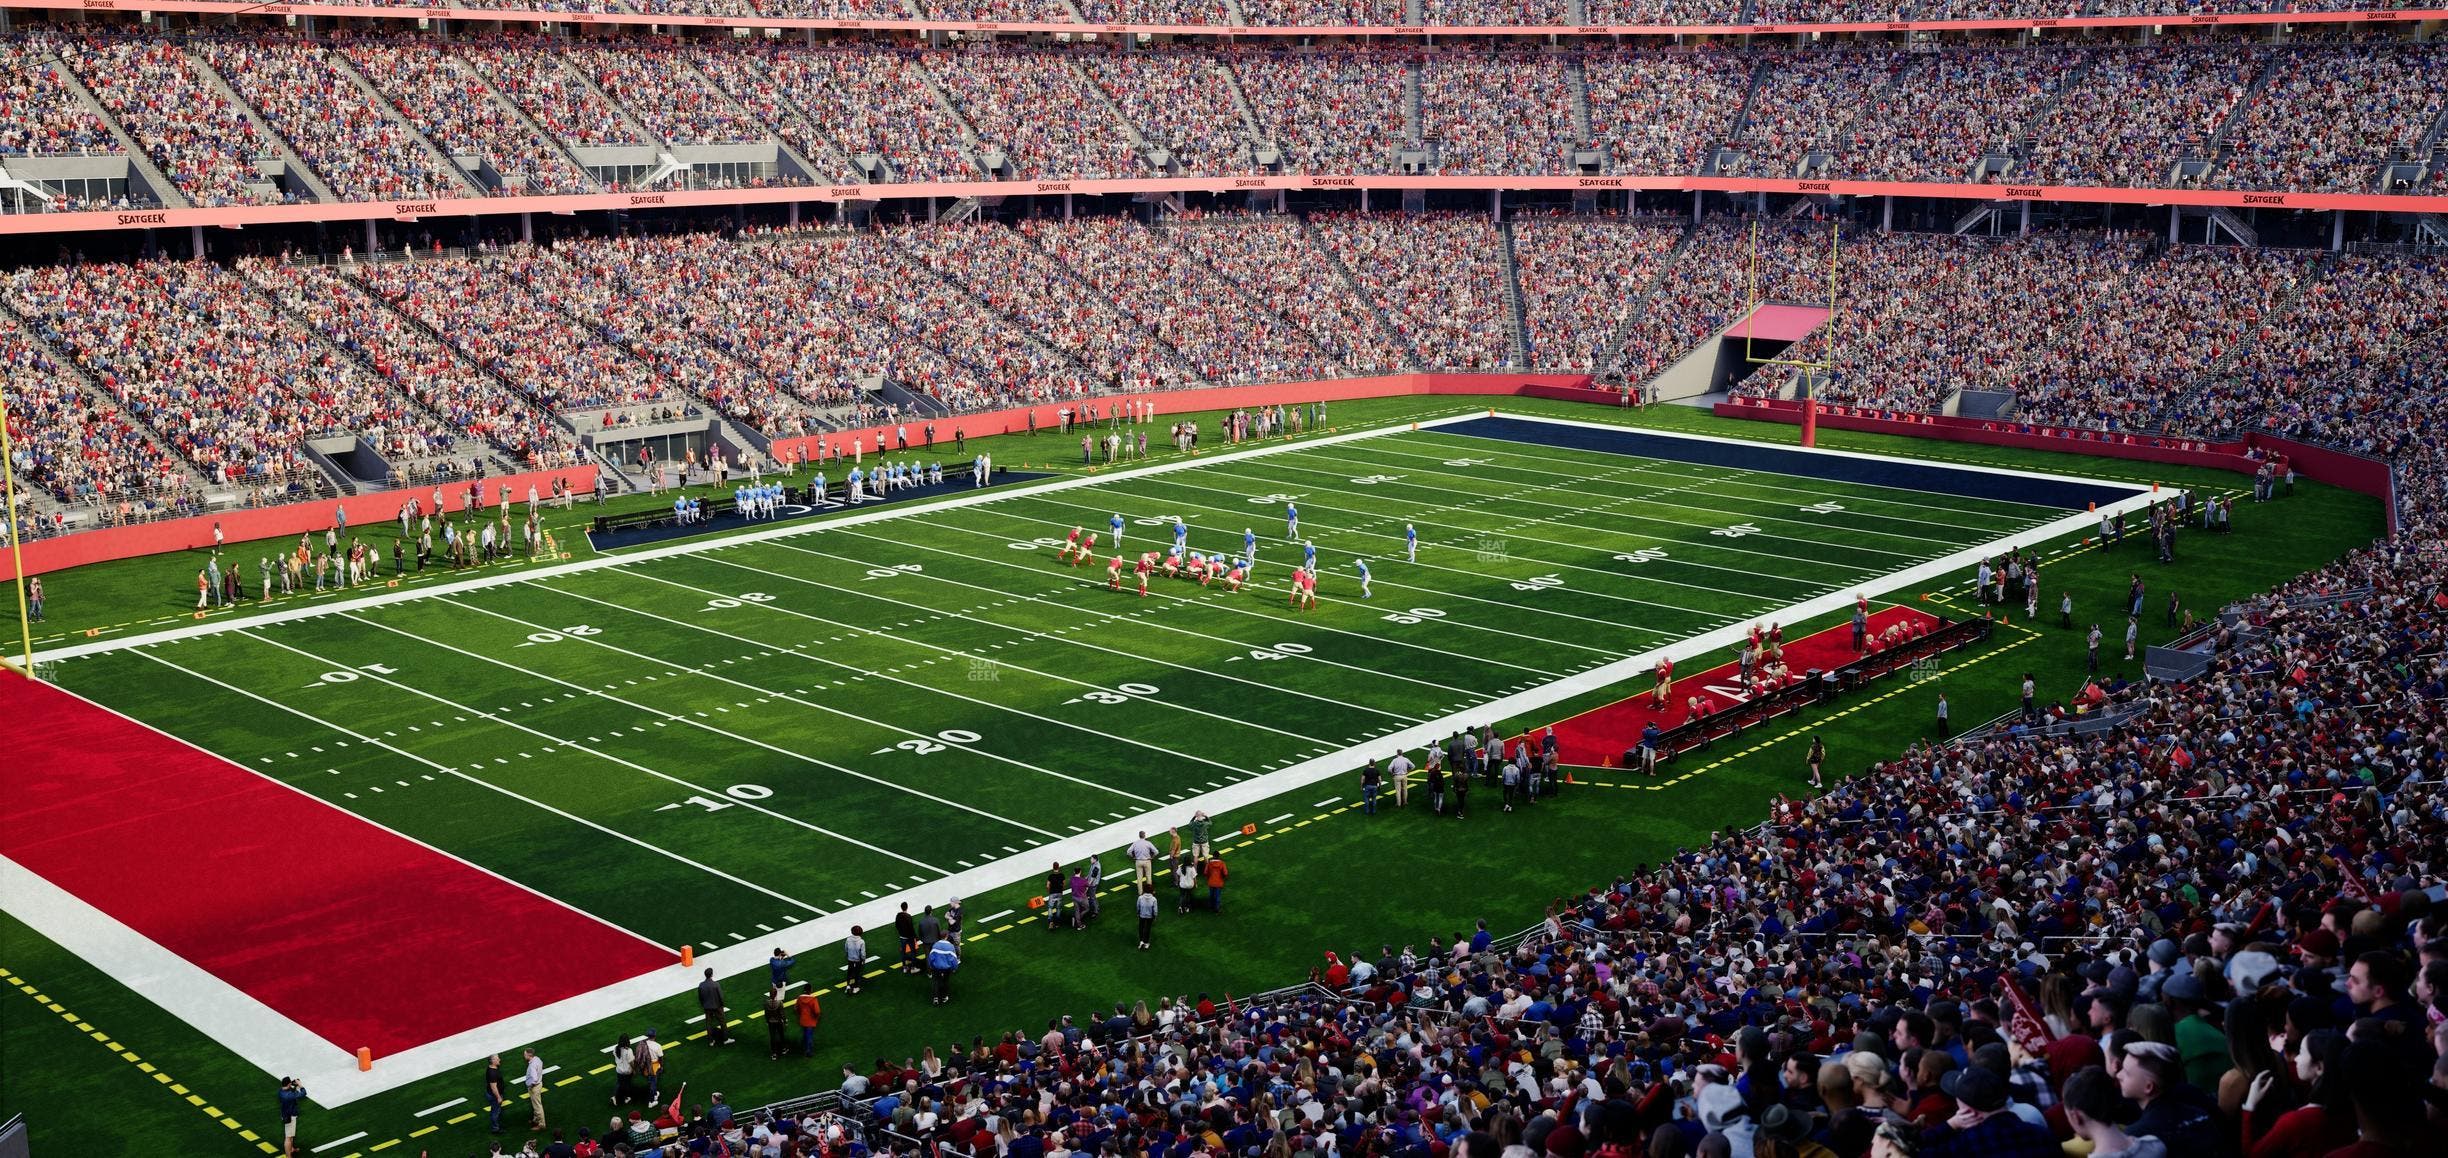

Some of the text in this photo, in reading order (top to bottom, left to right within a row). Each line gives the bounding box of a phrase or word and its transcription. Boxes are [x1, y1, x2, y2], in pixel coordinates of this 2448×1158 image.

[84, 0, 114, 8] SEATGEEK
[264, 5, 292, 13] SEATGEEK
[1038, 183, 1070, 192] SEATGEEK
[1236, 179, 1265, 187] SEATGEEK
[1312, 178, 1355, 186] SEATGEEK
[1579, 178, 1622, 187] SEATGEEK
[1799, 182, 1830, 191] SEATGEEK
[832, 188, 861, 196] SEATGEEK
[2006, 188, 2042, 198] SEATGEEK
[631, 195, 665, 205] SEATGEEK
[2243, 194, 2285, 205] SEATGEEK
[396, 204, 436, 214] SEATGEEK
[118, 213, 165, 225] SEATGEEK
[1350, 474, 1398, 485] 20
[1247, 493, 1298, 504] 30
[1709, 525, 1762, 537] 20
[1007, 537, 1066, 550] 50
[1613, 550, 1669, 563] 30
[866, 564, 922, 577] 40
[1510, 577, 1565, 591] 40
[707, 592, 776, 608] 30
[1381, 607, 1447, 625] 50
[526, 624, 603, 643] 20
[1249, 643, 1313, 661] 40
[320, 663, 399, 683] 10
[1082, 683, 1160, 704] 30
[896, 729, 982, 755] 20
[683, 784, 774, 812] 10
[1247, 825, 1254, 833] 20
